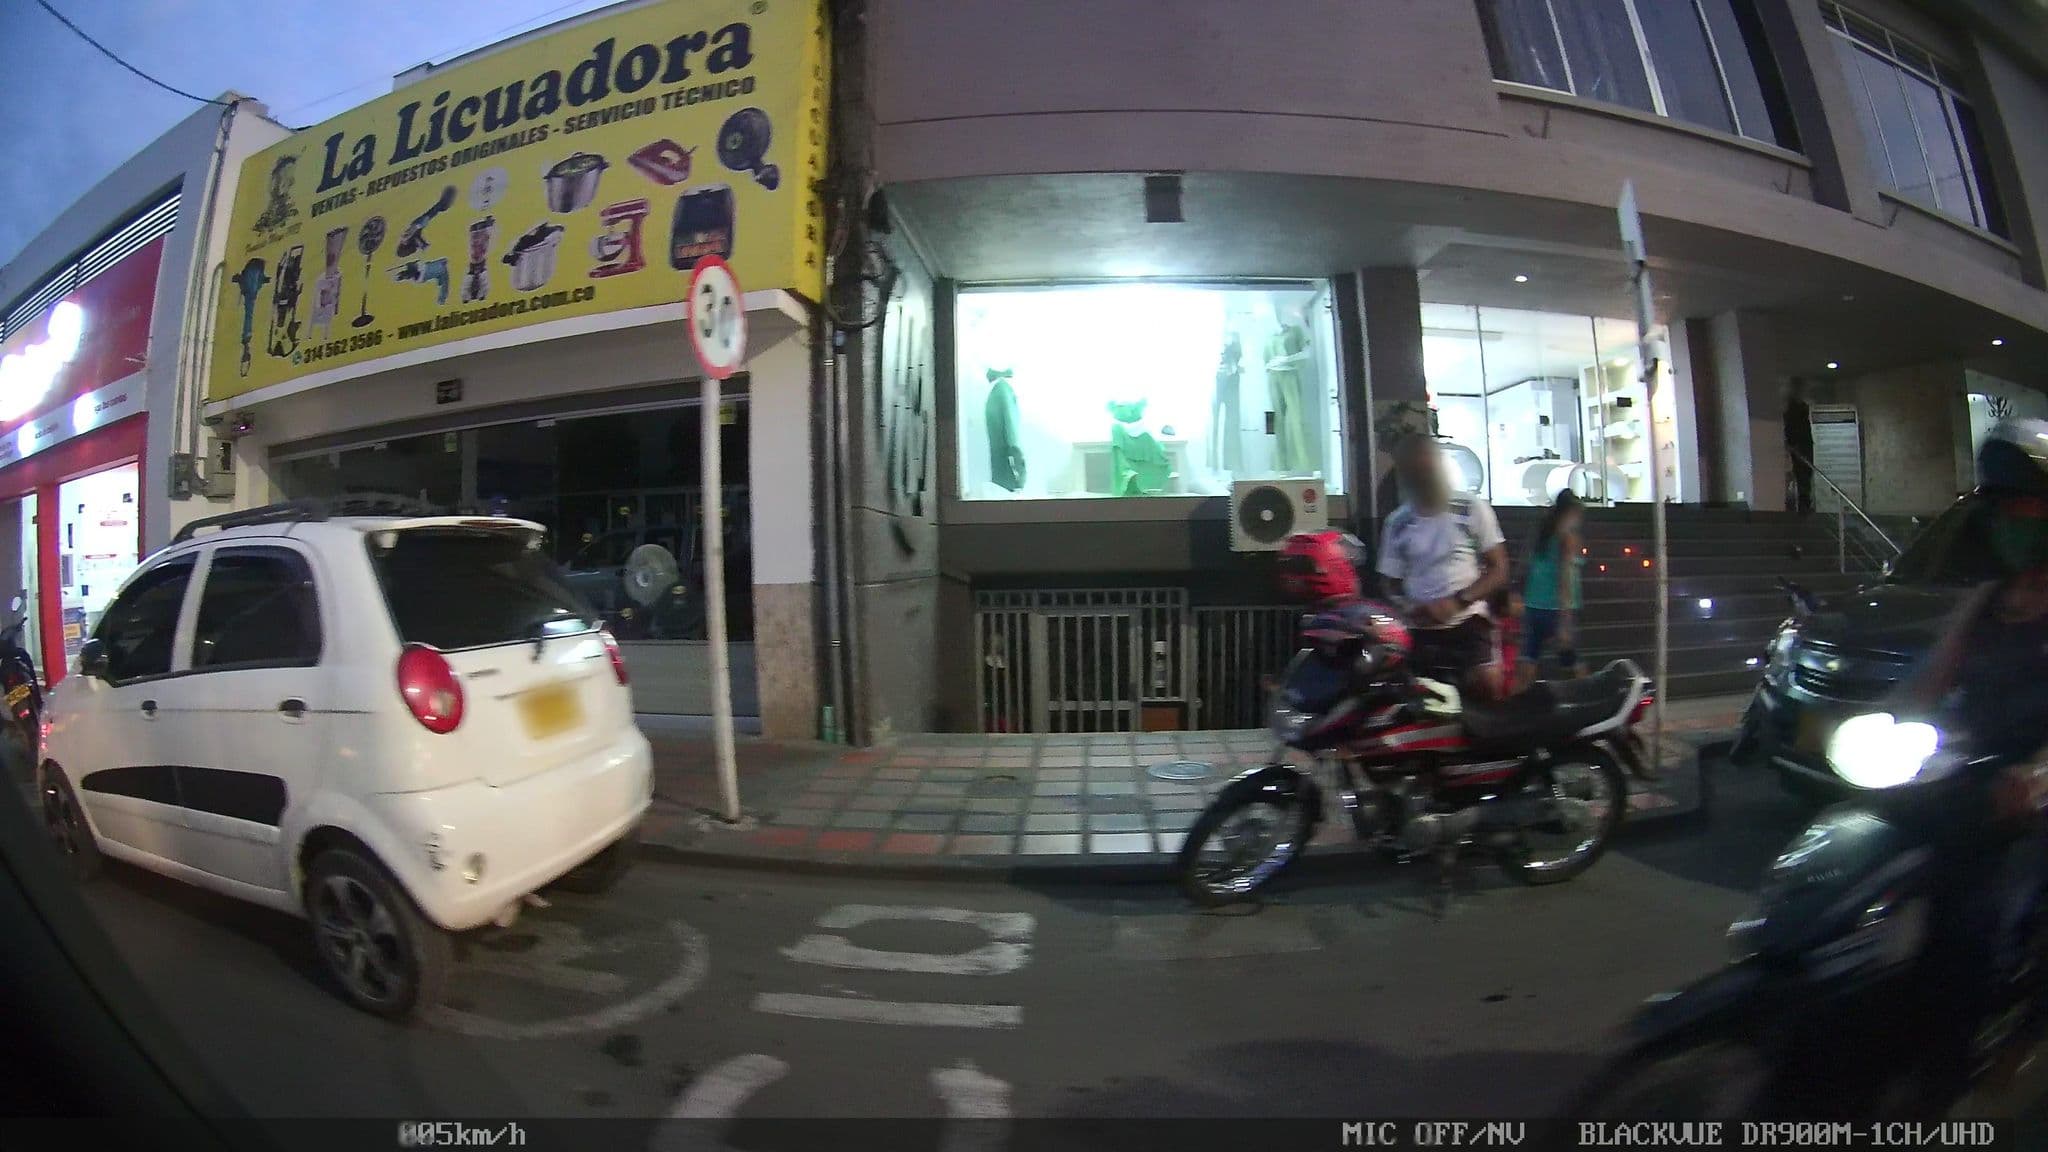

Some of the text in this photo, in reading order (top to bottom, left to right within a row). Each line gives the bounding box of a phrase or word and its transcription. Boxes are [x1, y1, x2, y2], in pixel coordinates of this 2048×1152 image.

[311, 187, 358, 218] VENTAS
[366, 155, 449, 198] REPUESTOS
[451, 123, 550, 168] ORIGINALES
[563, 96, 658, 135] SERVICIO
[661, 75, 757, 111] TÉCNICO
[316, 22, 754, 193] La Licuadora
[303, 344, 323, 363] 314
[325, 338, 348, 357] 562
[398, 286, 595, 339] www.lalicuadora.com.co
